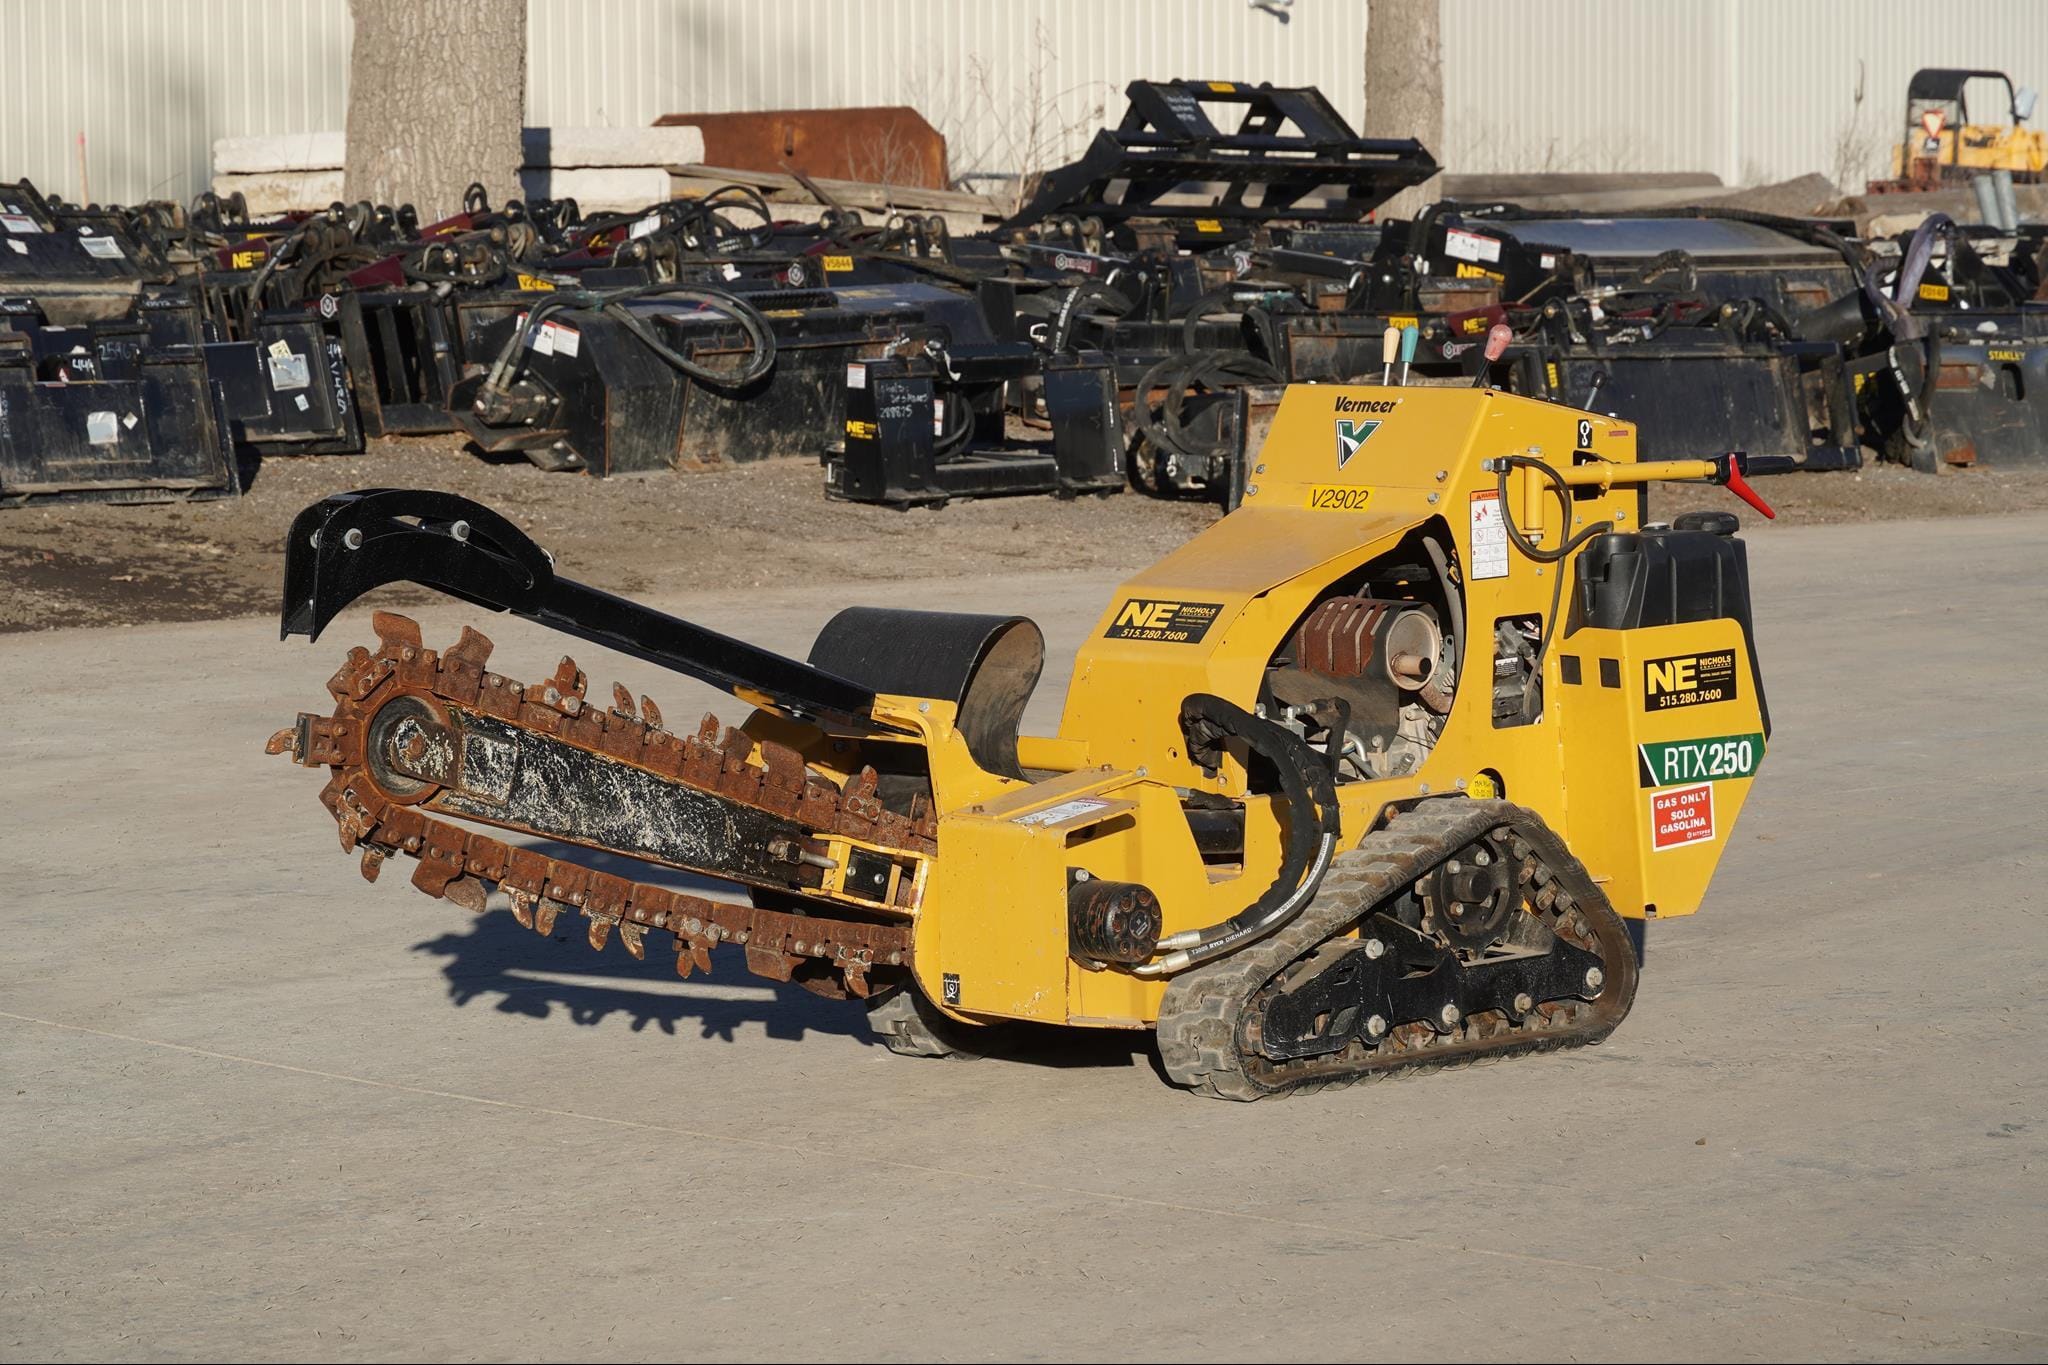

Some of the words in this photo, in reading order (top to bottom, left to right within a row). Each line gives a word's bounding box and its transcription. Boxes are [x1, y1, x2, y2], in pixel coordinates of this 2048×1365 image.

[232, 252, 253, 269] NE
[1463, 319, 1479, 332] NE
[1988, 350, 2025, 361] STANLEY
[1335, 396, 1396, 413] Vermeer
[846, 420, 865, 434] NE
[1311, 489, 1369, 509] V2902
[1116, 601, 1181, 628] NE
[1181, 606, 1217, 615] NICHOLS
[1121, 628, 1188, 640] 515.280.7600
[1700, 655, 1731, 666] NICHOLS
[1647, 658, 1697, 695] NE
[1660, 689, 1722, 707] 515.280.7600
[1664, 741, 1752, 780] RTX250
[1657, 798, 1677, 809] GAS
[1681, 791, 1707, 805] ONLY
[1671, 808, 1695, 820] SOLO
[1660, 817, 1706, 834] GASOLINA
